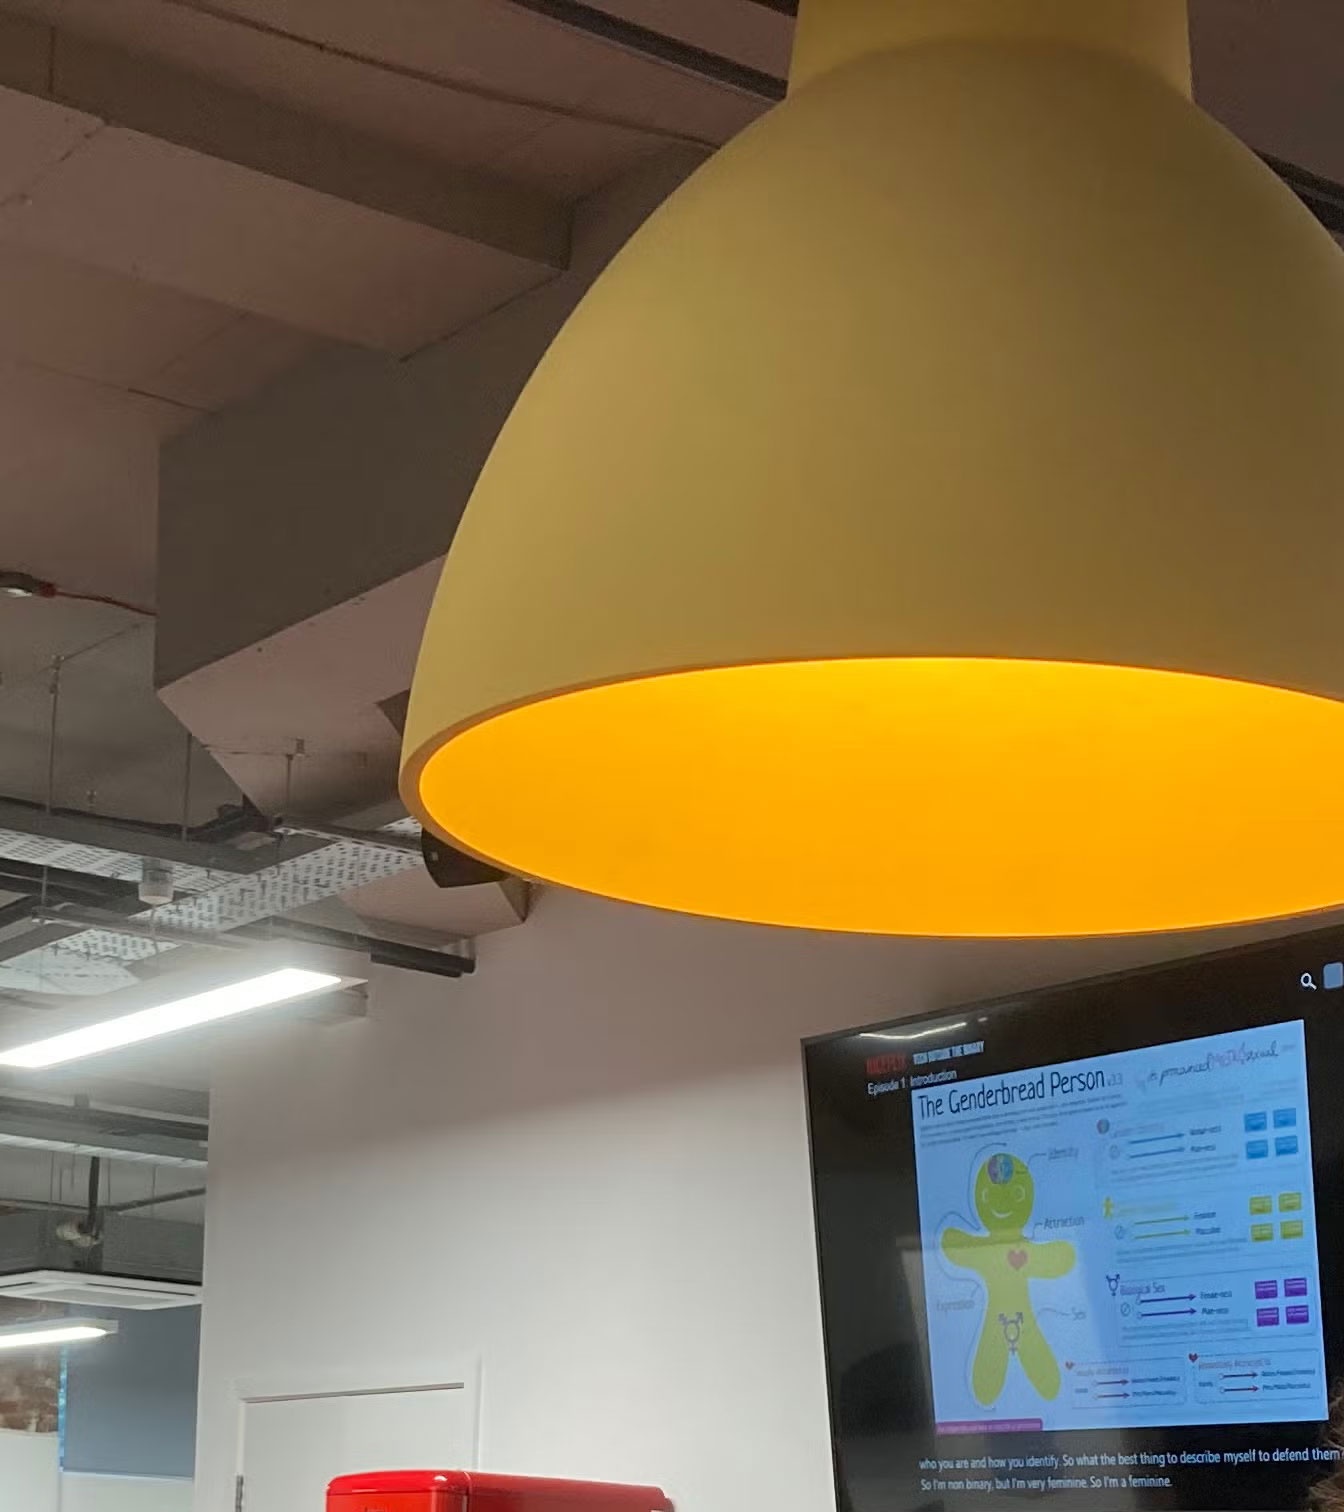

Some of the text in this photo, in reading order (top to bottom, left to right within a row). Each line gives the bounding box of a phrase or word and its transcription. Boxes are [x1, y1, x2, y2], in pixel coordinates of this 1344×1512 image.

[910, 1069, 958, 1086] Introduction
[918, 1094, 944, 1119] The
[948, 1071, 1046, 1114] Genderbread
[1050, 1069, 1105, 1097] Person
[919, 1458, 936, 1469] who
[938, 1459, 954, 1473] you
[956, 1459, 969, 1469] are
[970, 1456, 986, 1468] and
[987, 1456, 1006, 1468] how
[1007, 1458, 1025, 1471] you
[1062, 1454, 1074, 1467] So
[1076, 1453, 1098, 1466] what
[1100, 1452, 1116, 1466] the
[1117, 1452, 1138, 1465] best
[1139, 1451, 1165, 1468] thing
[1166, 1452, 1178, 1464] to
[1179, 1450, 1221, 1464] describe
[1223, 1448, 1256, 1466] myself
[1258, 1449, 1270, 1462] to
[1272, 1447, 1309, 1461] defend
[920, 1478, 932, 1491] So
[933, 1478, 946, 1490] I'm
[947, 1480, 964, 1490] non
[995, 1477, 1010, 1490] but
[1011, 1477, 1026, 1489] I'm
[1027, 1479, 1045, 1492] very
[1089, 1475, 1102, 1489] So
[1103, 1475, 1119, 1488] I'm
[1120, 1477, 1127, 1488] a
